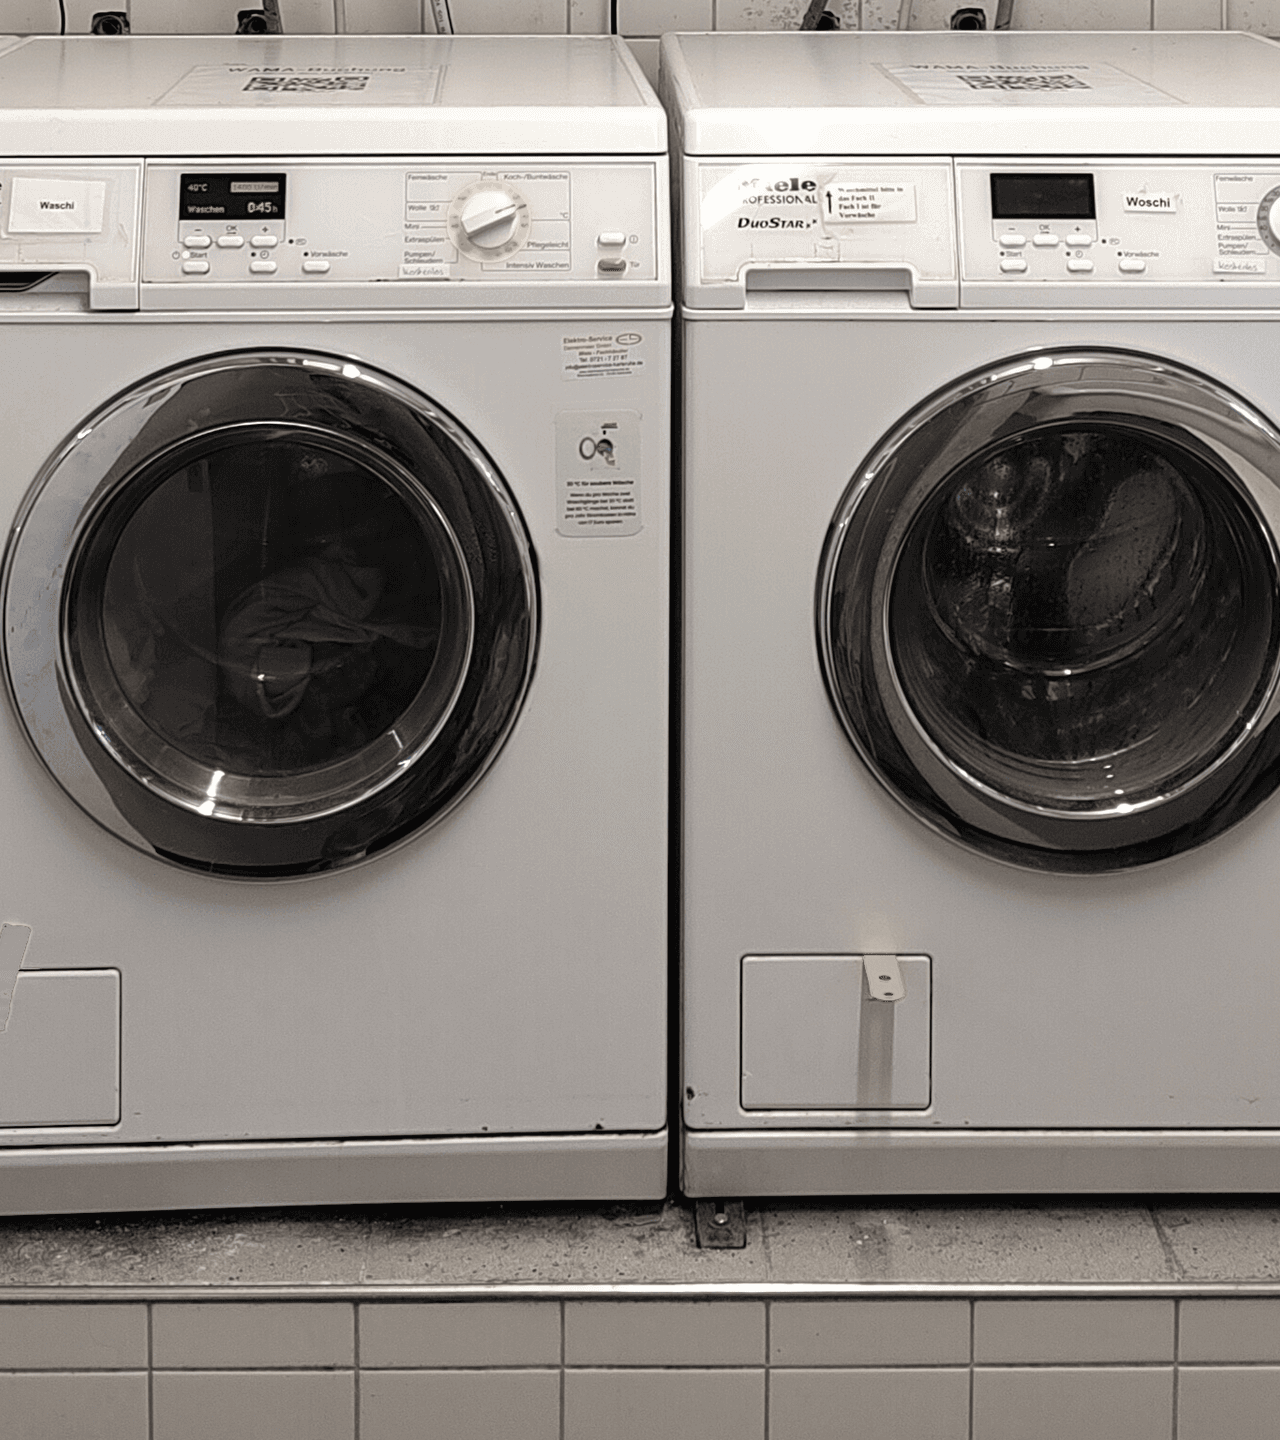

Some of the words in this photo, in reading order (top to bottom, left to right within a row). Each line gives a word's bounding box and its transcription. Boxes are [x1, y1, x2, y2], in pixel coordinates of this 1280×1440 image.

[39, 201, 75, 210] Waschi
[1126, 196, 1171, 208] Woschi
[187, 205, 225, 214] Waschen
[526, 241, 569, 249] Pflegeleicht
[190, 251, 208, 259] Start
[310, 250, 349, 258] Vorwäsche
[1006, 250, 1023, 258] Start
[1124, 250, 1159, 258] Vorwäsche
[505, 261, 534, 269] Intensiv
[535, 261, 570, 269] Waschen
[563, 335, 613, 344] Elektro-Service
